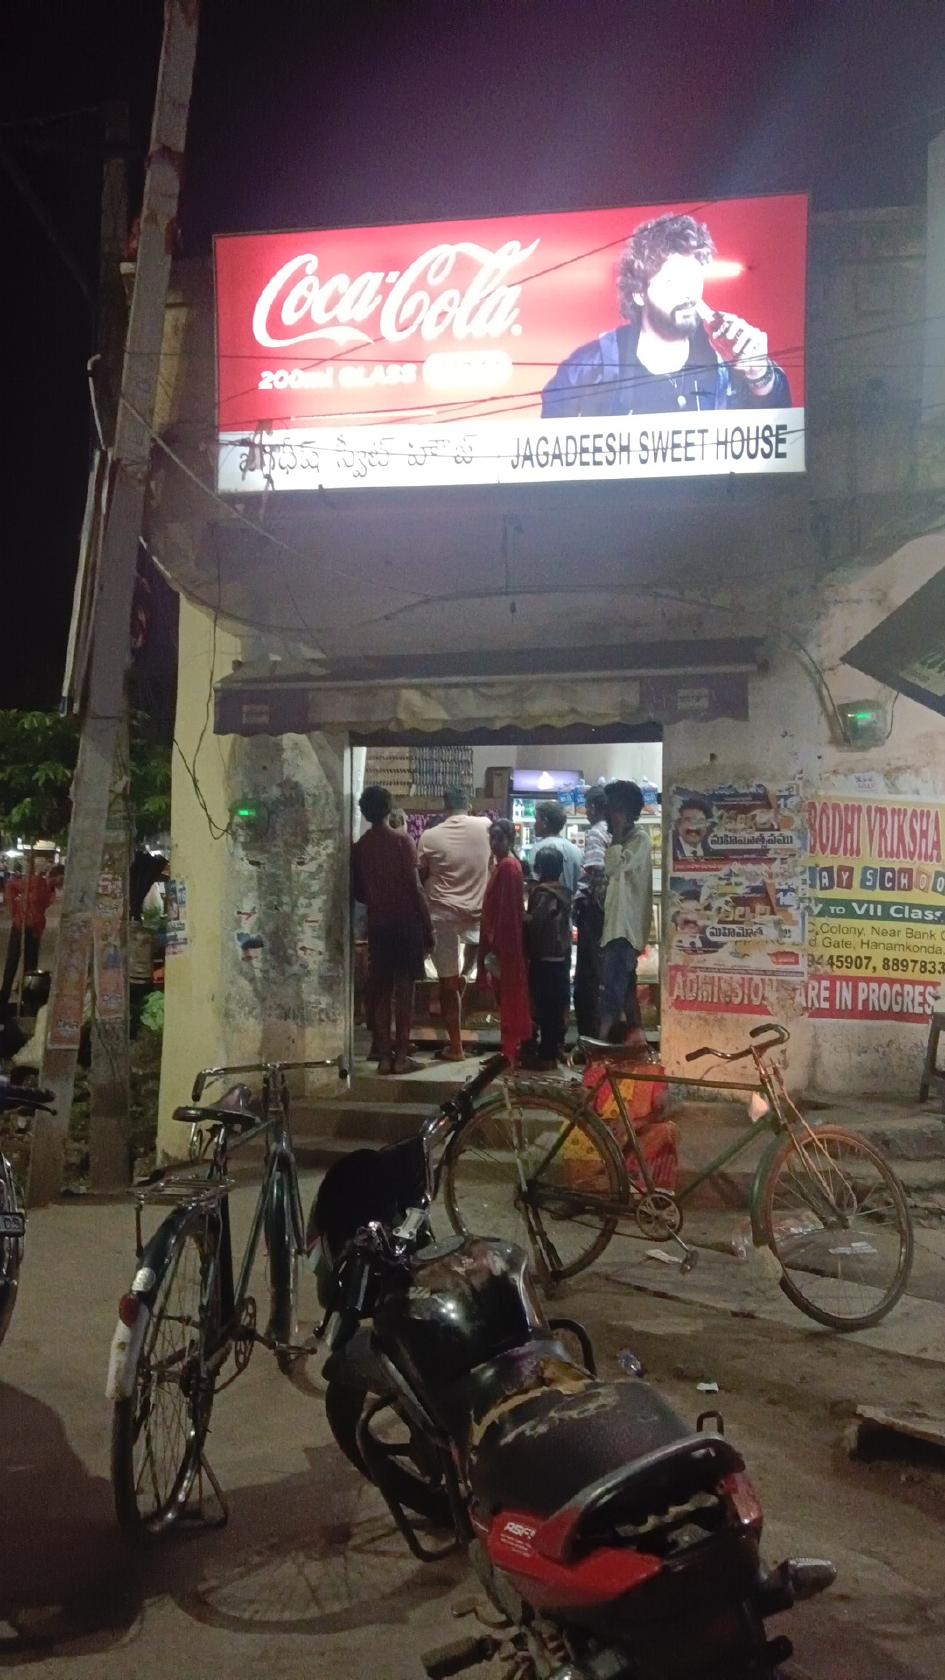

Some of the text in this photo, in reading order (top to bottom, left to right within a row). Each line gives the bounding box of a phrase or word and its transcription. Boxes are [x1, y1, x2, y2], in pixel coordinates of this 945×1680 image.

[338, 363, 417, 387] GLASS
[511, 424, 788, 469] JAGADEESH SWEET HOUSE
[807, 802, 862, 857] BODHI
[866, 804, 942, 863] VRIKSHA
[852, 902, 882, 916] VII
[871, 926, 902, 937] Near
[905, 928, 937, 940] Bank
[836, 981, 852, 1010] IN
